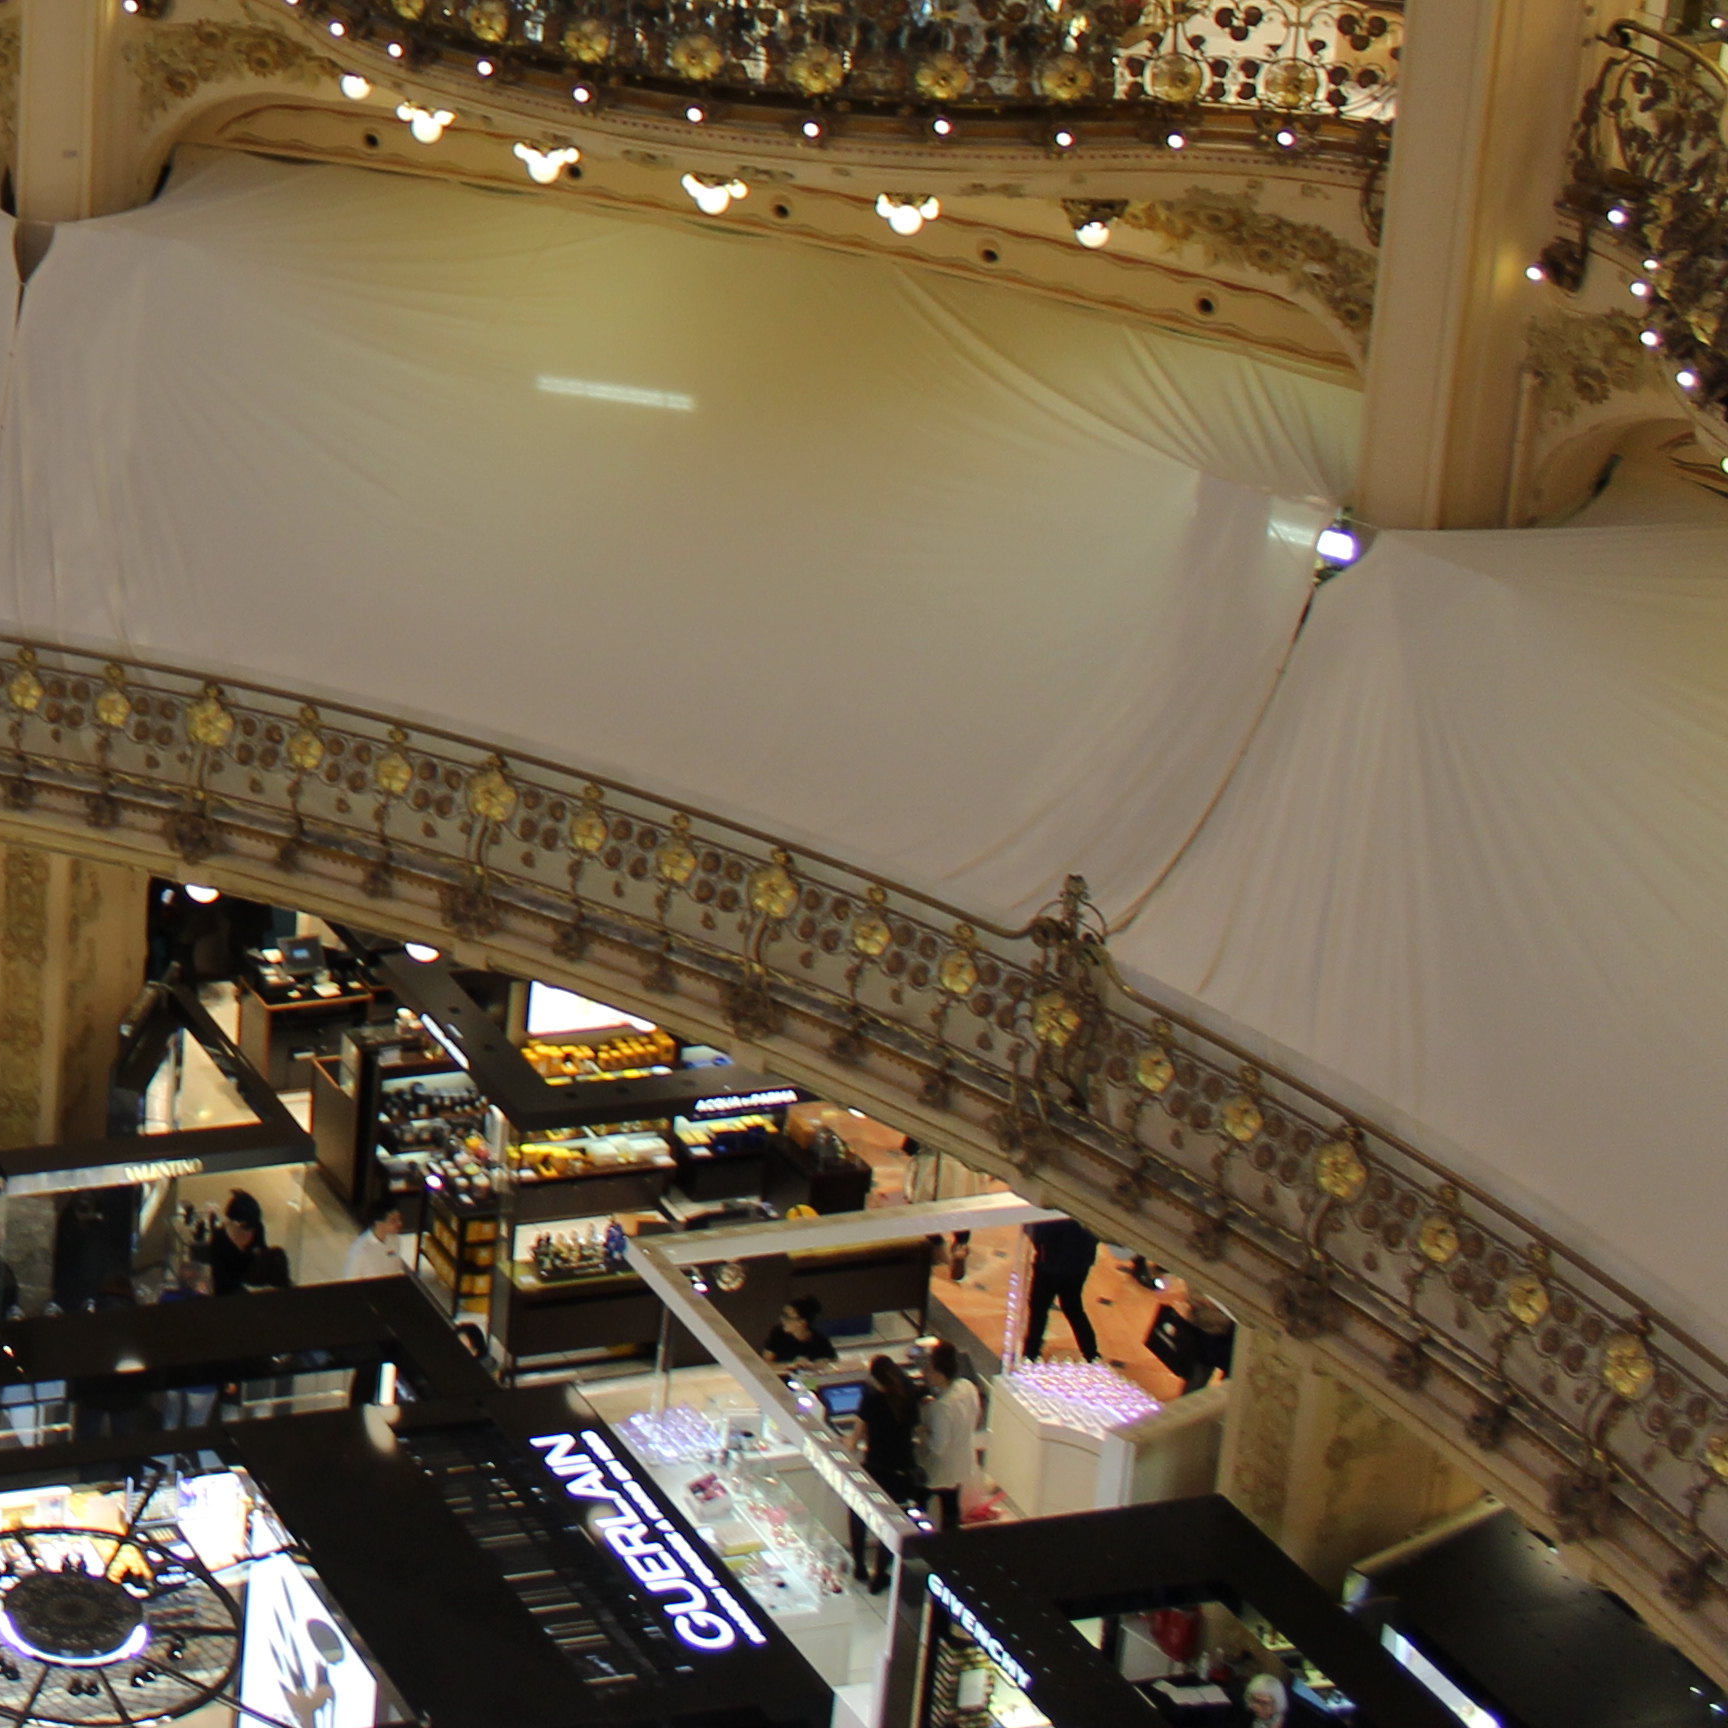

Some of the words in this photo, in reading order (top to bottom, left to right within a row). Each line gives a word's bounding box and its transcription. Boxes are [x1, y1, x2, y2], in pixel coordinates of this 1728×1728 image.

[695, 1096, 742, 1112] ACQUA
[751, 1090, 798, 1106] PARMA
[530, 1433, 736, 1649] GUERLAIN
[927, 1573, 1033, 1689] GIVENCHY
